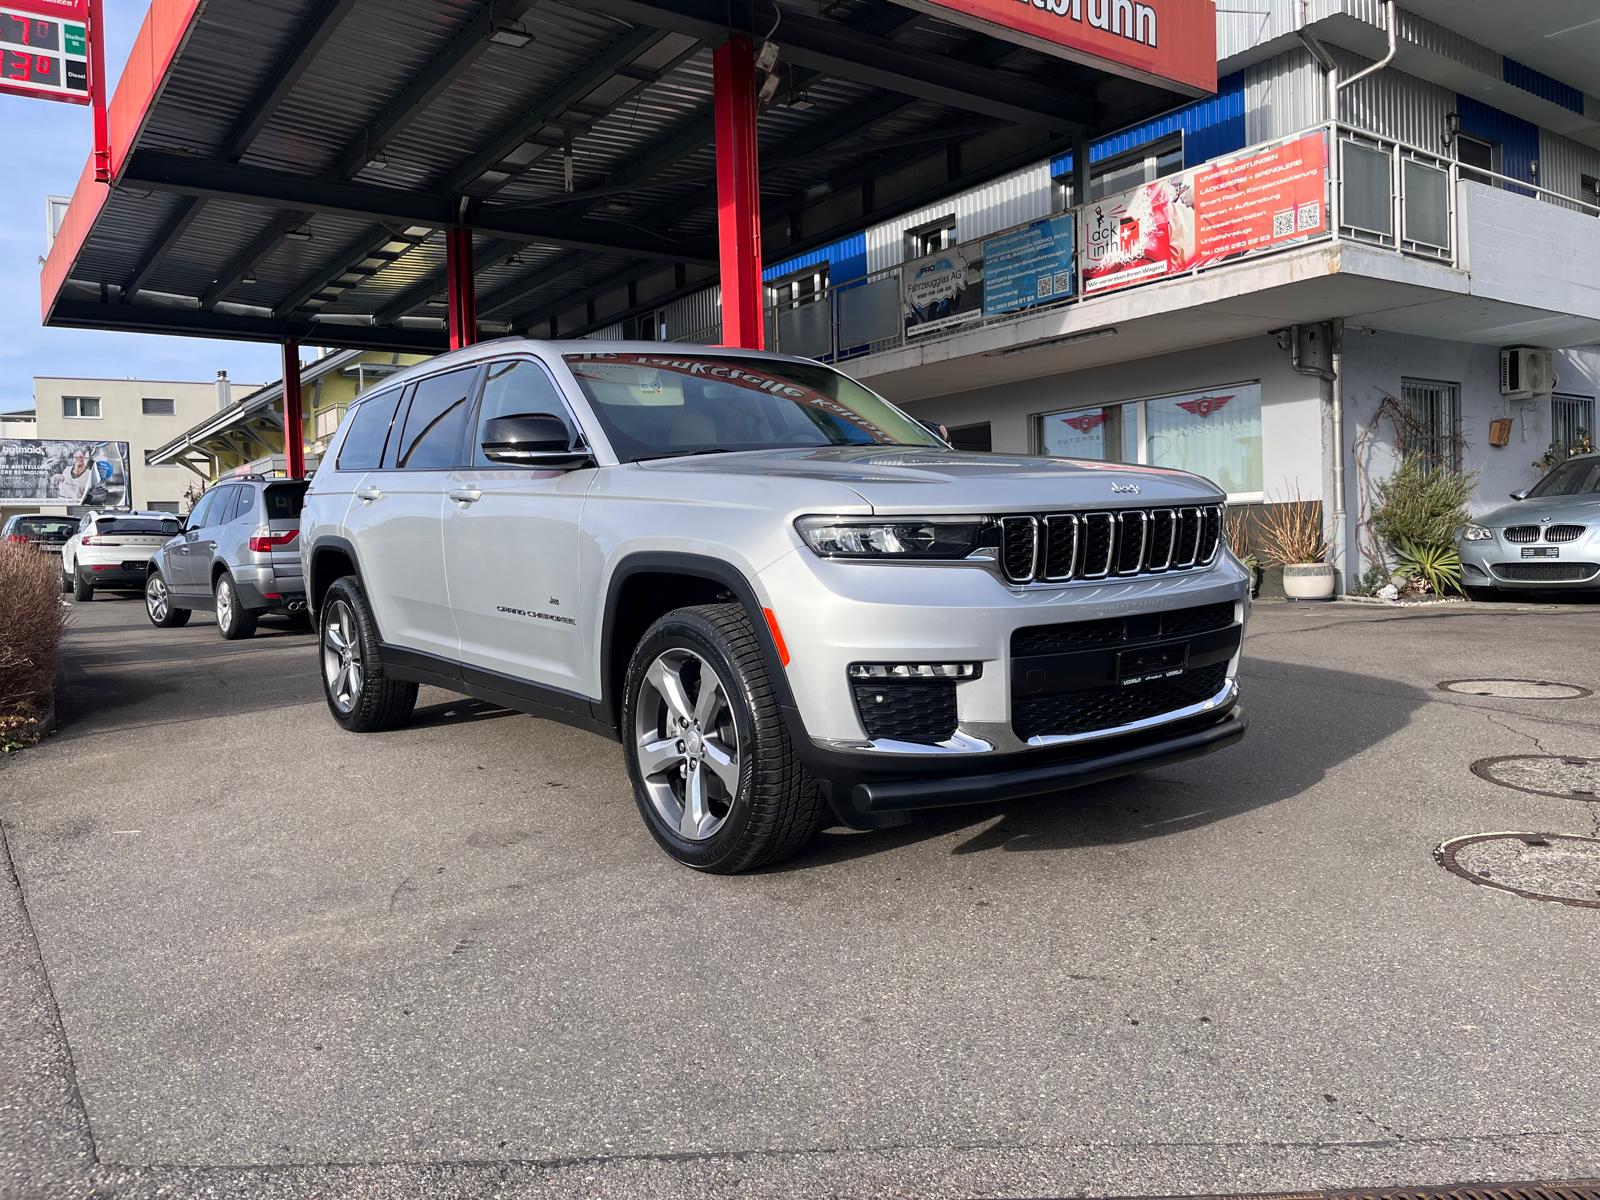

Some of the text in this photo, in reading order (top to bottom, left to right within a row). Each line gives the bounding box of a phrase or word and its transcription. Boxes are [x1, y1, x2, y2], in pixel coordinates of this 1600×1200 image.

[67, 71, 86, 80] Diesel
[1199, 153, 1278, 182] UNSERE LEISTUNGEN
[1199, 176, 1247, 195] LACKIEREREI
[1254, 159, 1303, 179] SPENGLEREI
[1199, 197, 1221, 208] Smart
[1200, 208, 1227, 219] Polieren
[1234, 194, 1281, 210] Aufbereitung
[1200, 228, 1252, 244] Unfallfahrzeuge
[907, 269, 961, 293] Fahrzeugglas AG
[1087, 279, 1097, 287] Wir
[1111, 481, 1141, 495] Jeep
